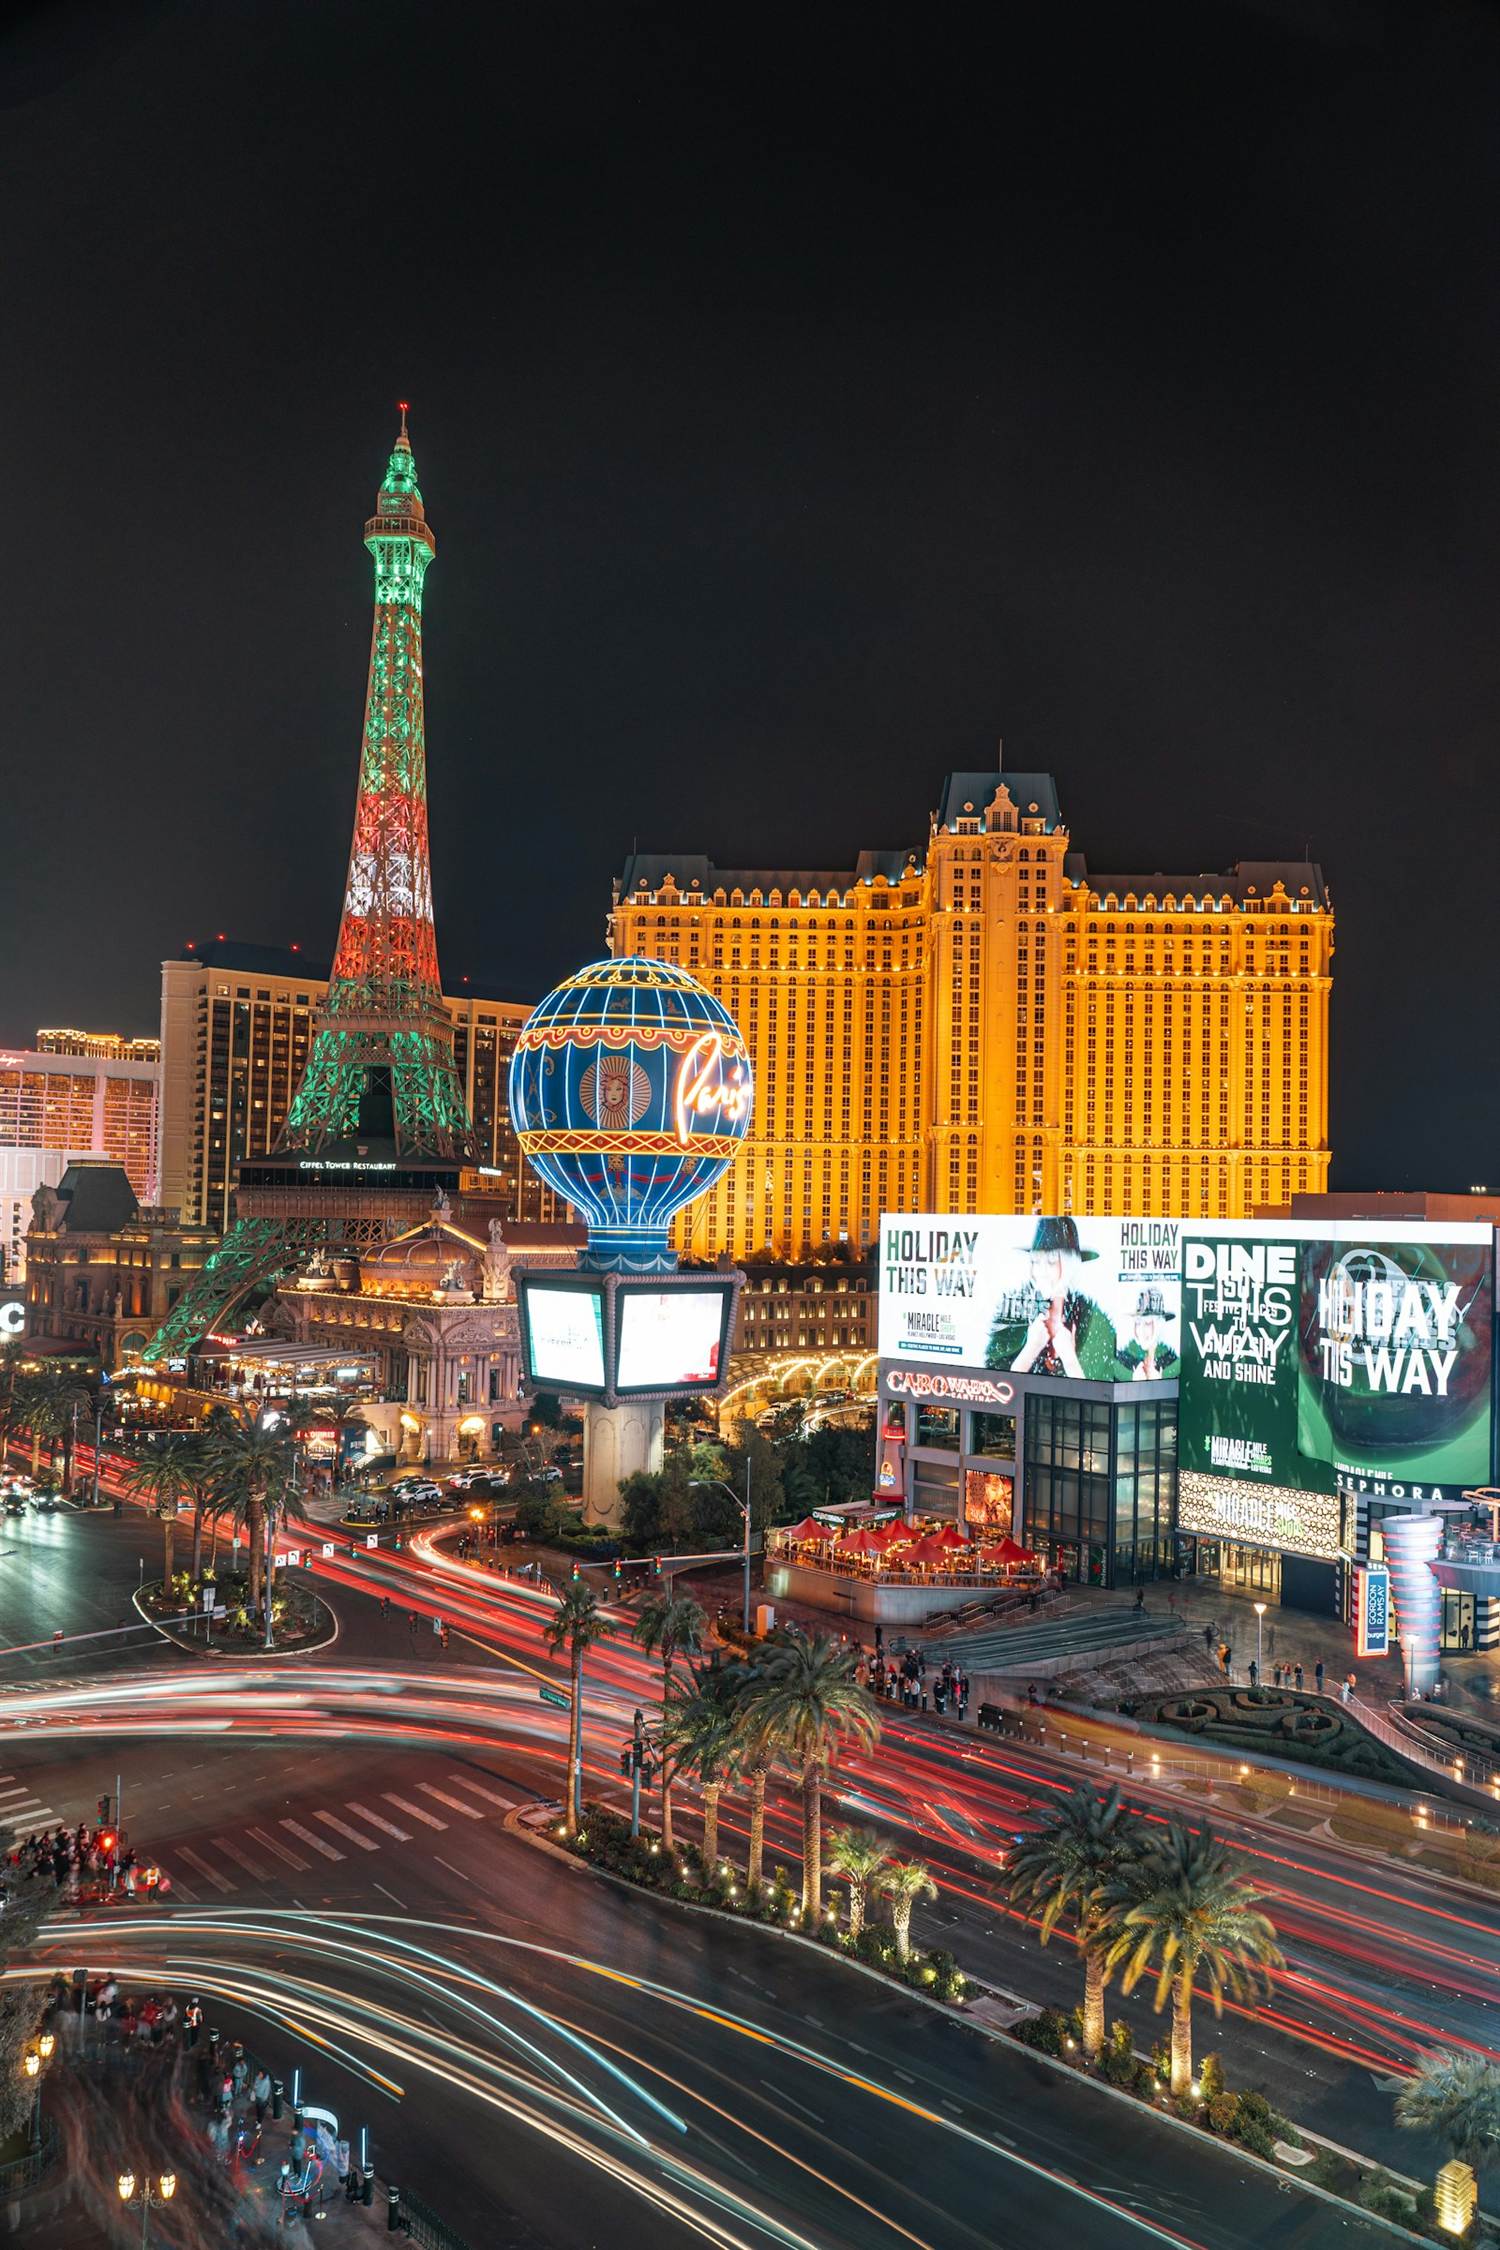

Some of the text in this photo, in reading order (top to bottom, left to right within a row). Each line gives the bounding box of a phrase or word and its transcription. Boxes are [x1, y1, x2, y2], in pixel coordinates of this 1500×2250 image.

[674, 1032, 752, 1144] Paris
[887, 1230, 979, 1264] HOLIDAY
[1121, 1223, 1178, 1246] HOLIDAY
[1121, 1250, 1178, 1269] THIS WAY
[1185, 1243, 1296, 1285] DINE
[886, 1266, 977, 1298] THIS WAY
[1185, 1282, 1292, 1326] THIS
[907, 1312, 940, 1332] MIRACLE
[1203, 1359, 1276, 1386] AND SHINE
[1362, 1345, 1459, 1396] WAY
[1335, 1473, 1443, 1501] SEPHORA
[1368, 1584, 1377, 1625] GORDON
[1377, 1584, 1385, 1625] RAMSAY
[1367, 1631, 1385, 1640] burger
